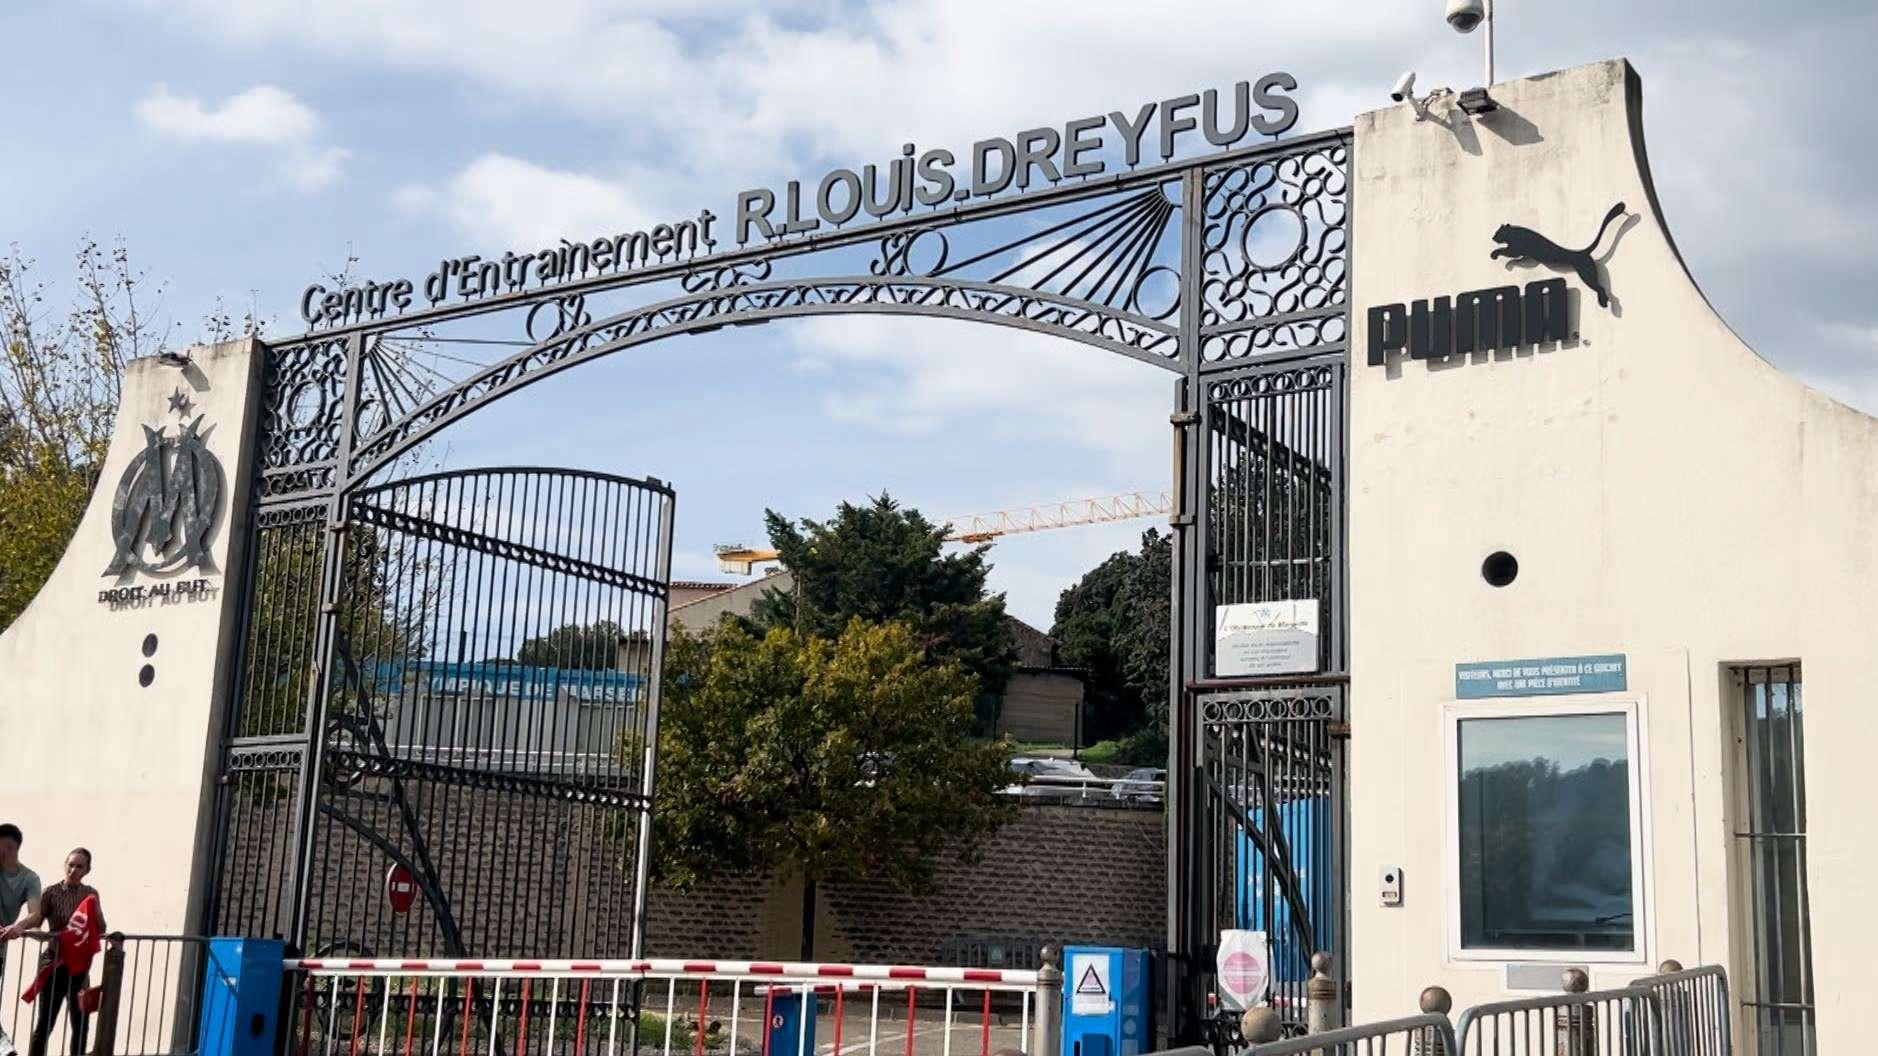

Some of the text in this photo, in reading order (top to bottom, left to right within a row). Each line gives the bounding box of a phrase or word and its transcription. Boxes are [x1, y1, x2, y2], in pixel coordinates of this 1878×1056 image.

[301, 278, 413, 324] Centre
[1367, 277, 1569, 368] PUMA
[98, 579, 208, 603] DROIT AU BUT
